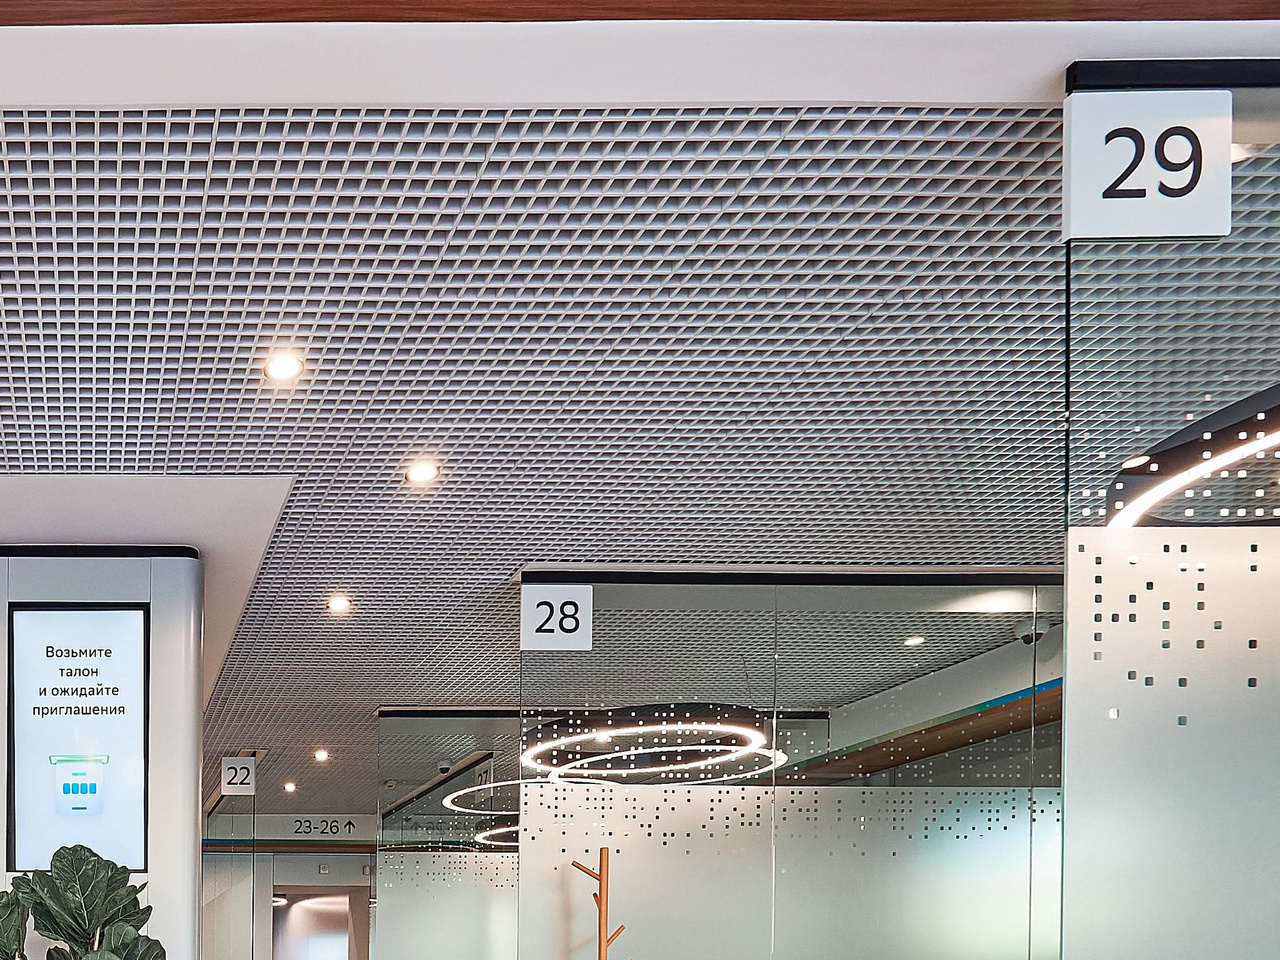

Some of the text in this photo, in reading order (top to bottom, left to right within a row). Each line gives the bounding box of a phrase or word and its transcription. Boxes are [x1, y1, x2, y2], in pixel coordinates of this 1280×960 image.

[1100, 125, 1204, 200] 29
[533, 599, 581, 635] 28
[45, 645, 113, 659] Возьмите
[58, 667, 99, 678] талон
[38, 682, 120, 698] и ожидайте
[32, 705, 125, 719] приглашения
[226, 766, 251, 786] 22
[477, 769, 489, 792] 27
[293, 819, 340, 835] 23-26
